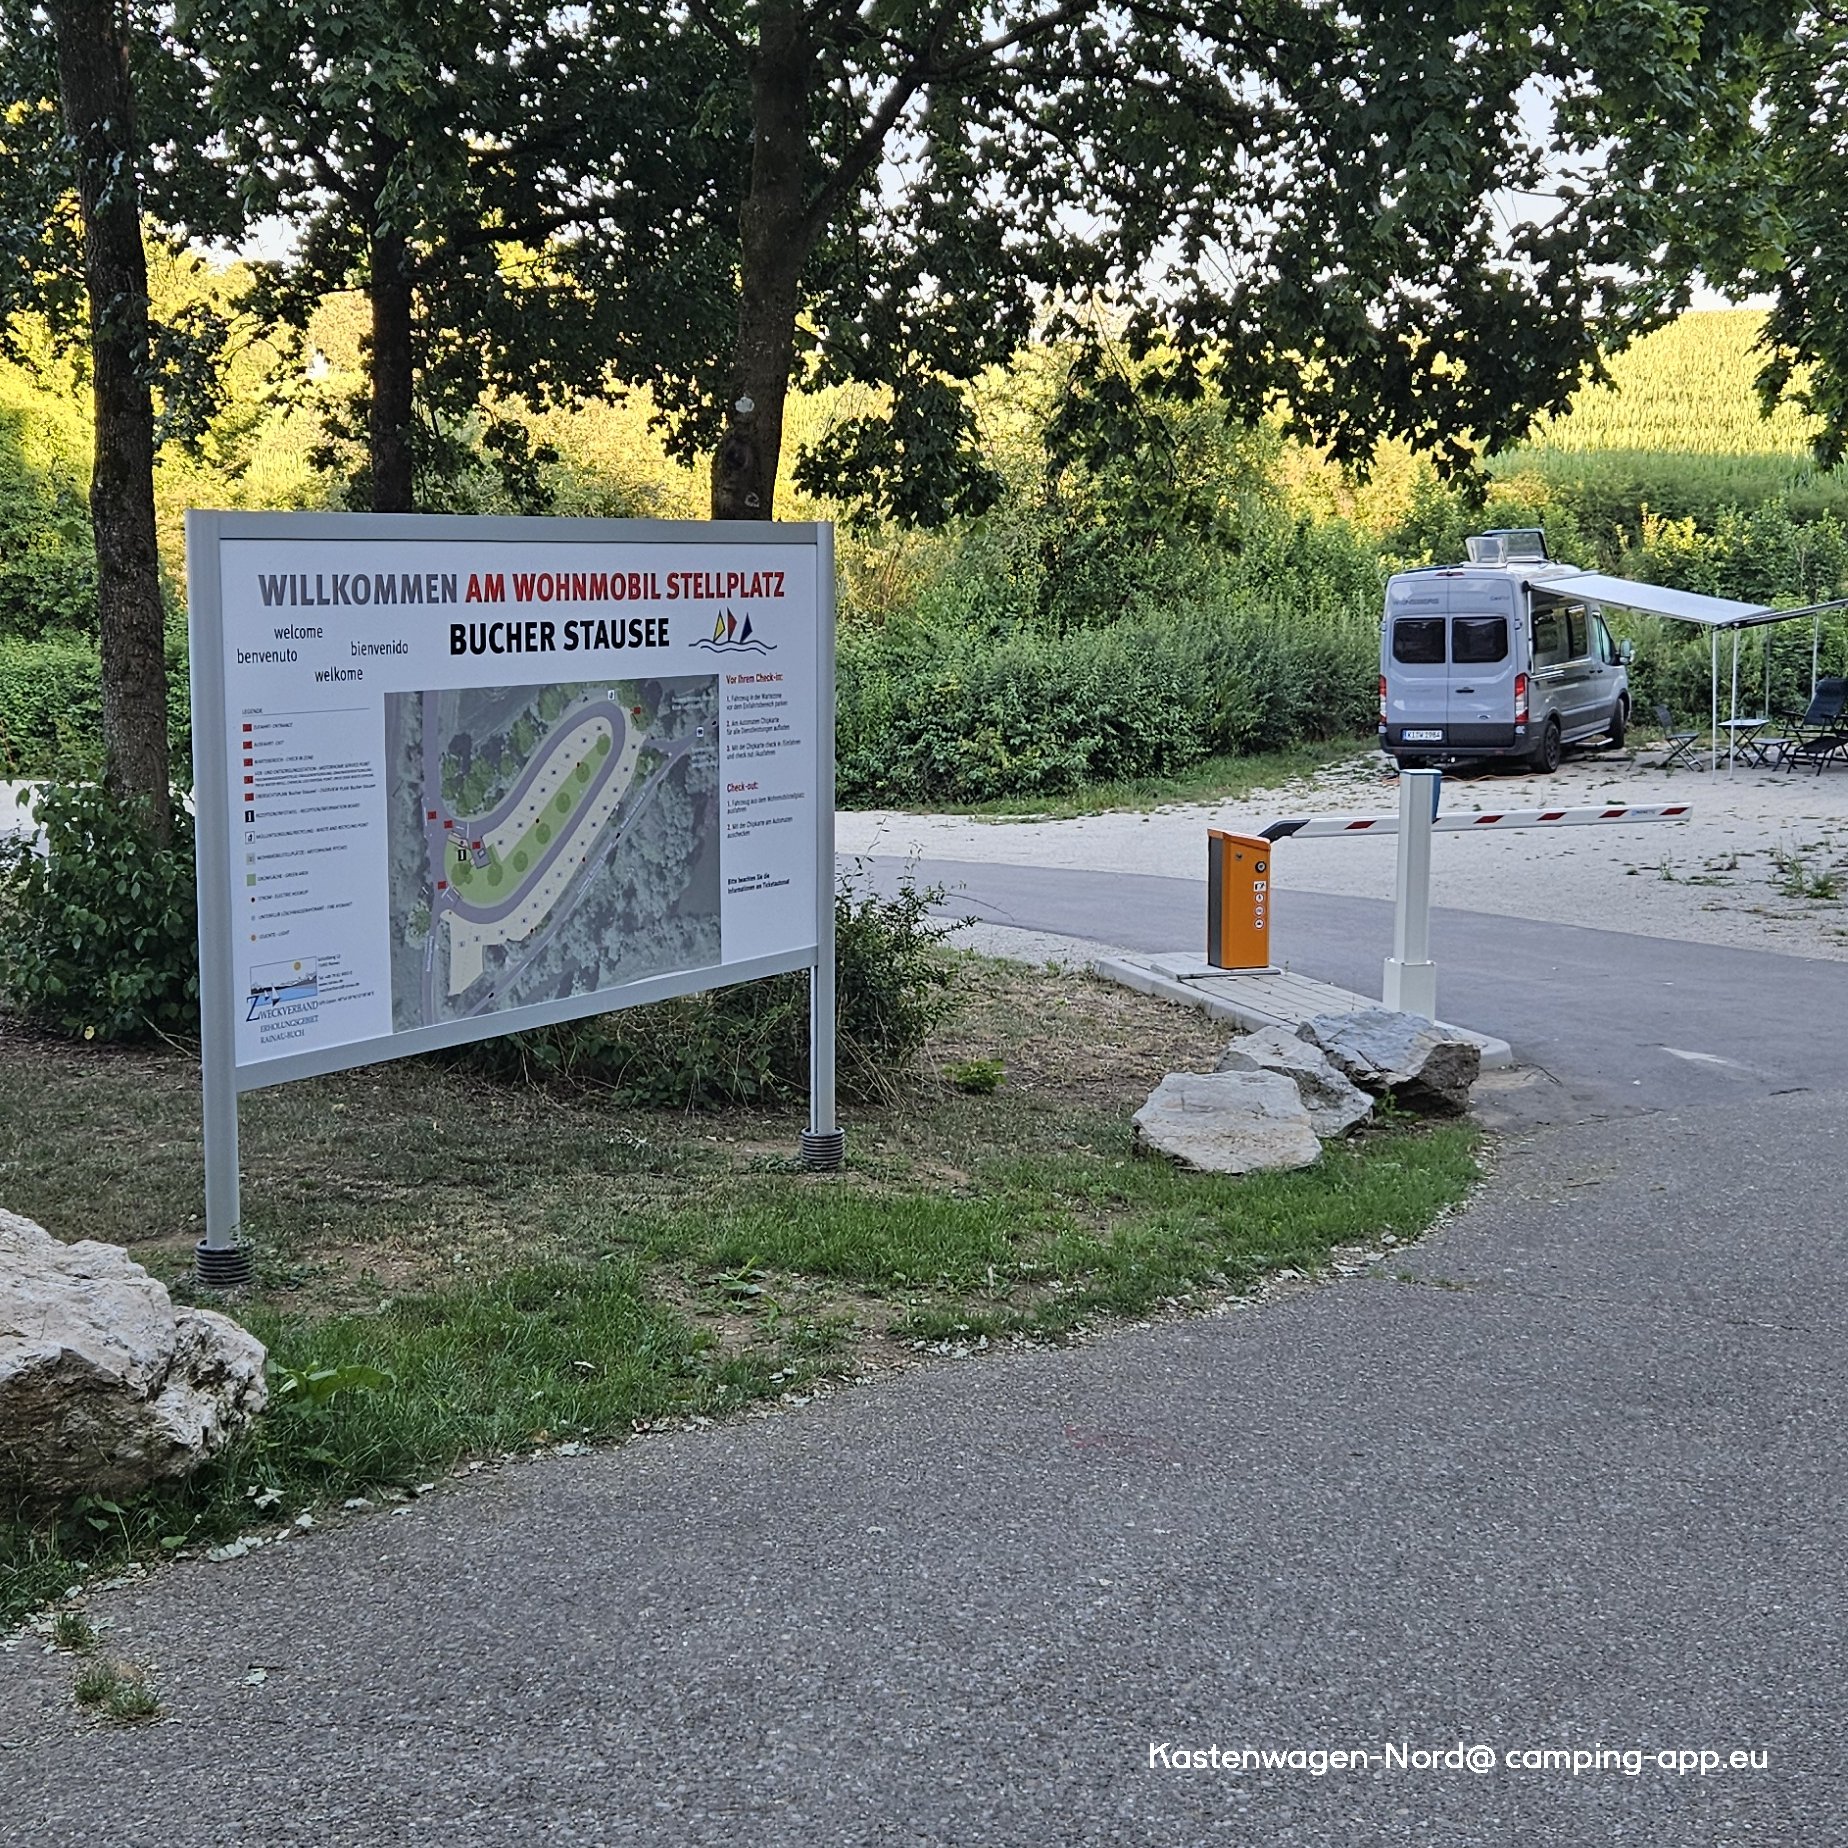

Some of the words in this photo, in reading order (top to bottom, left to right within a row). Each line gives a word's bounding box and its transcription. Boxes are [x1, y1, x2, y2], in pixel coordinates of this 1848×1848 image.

[257, 573, 457, 606] WILLKOMMEN
[465, 573, 506, 603] AM
[512, 572, 661, 602] WOHNMOBIL
[666, 571, 785, 599] STELLPLATZ
[274, 624, 323, 640] welcome
[450, 621, 556, 655] BUCHER
[563, 618, 670, 650] STAUSEE
[237, 648, 298, 663] benvenuto
[351, 640, 409, 656] bienvenido
[315, 667, 363, 682] welkome
[726, 674, 737, 684] Vor
